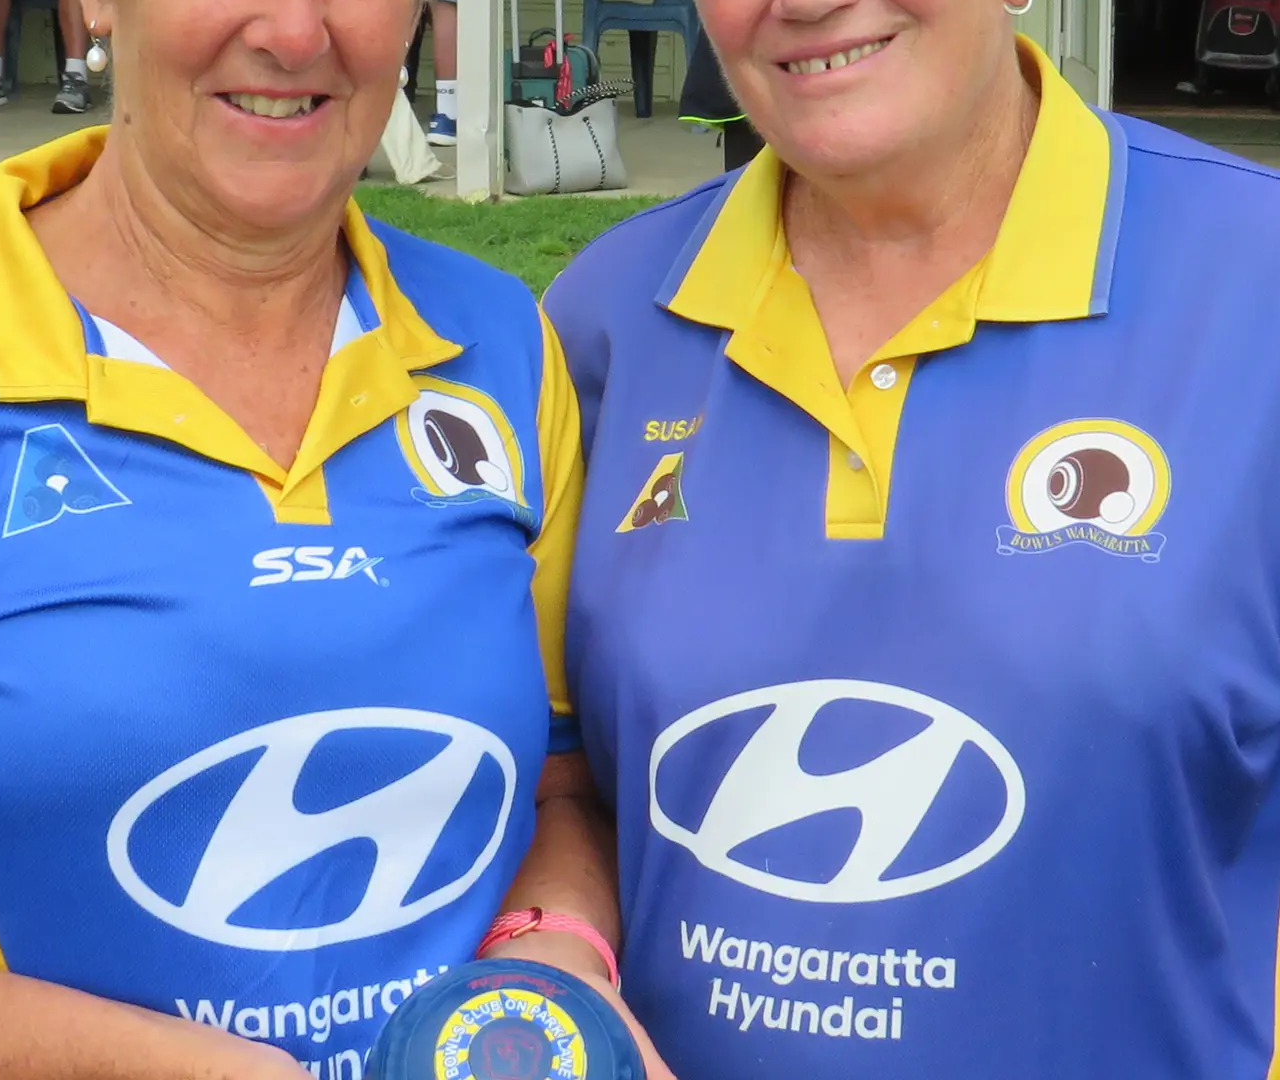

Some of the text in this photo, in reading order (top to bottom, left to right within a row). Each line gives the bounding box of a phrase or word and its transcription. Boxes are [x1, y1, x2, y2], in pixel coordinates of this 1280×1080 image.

[249, 546, 384, 587] SSA
[1010, 526, 1151, 553] BOWLS WANGARATTA
[680, 920, 956, 989] Wangaratta
[444, 999, 573, 1079] BOWLS CLUB ON PARK LANE
[708, 977, 903, 1039] Hyundai
